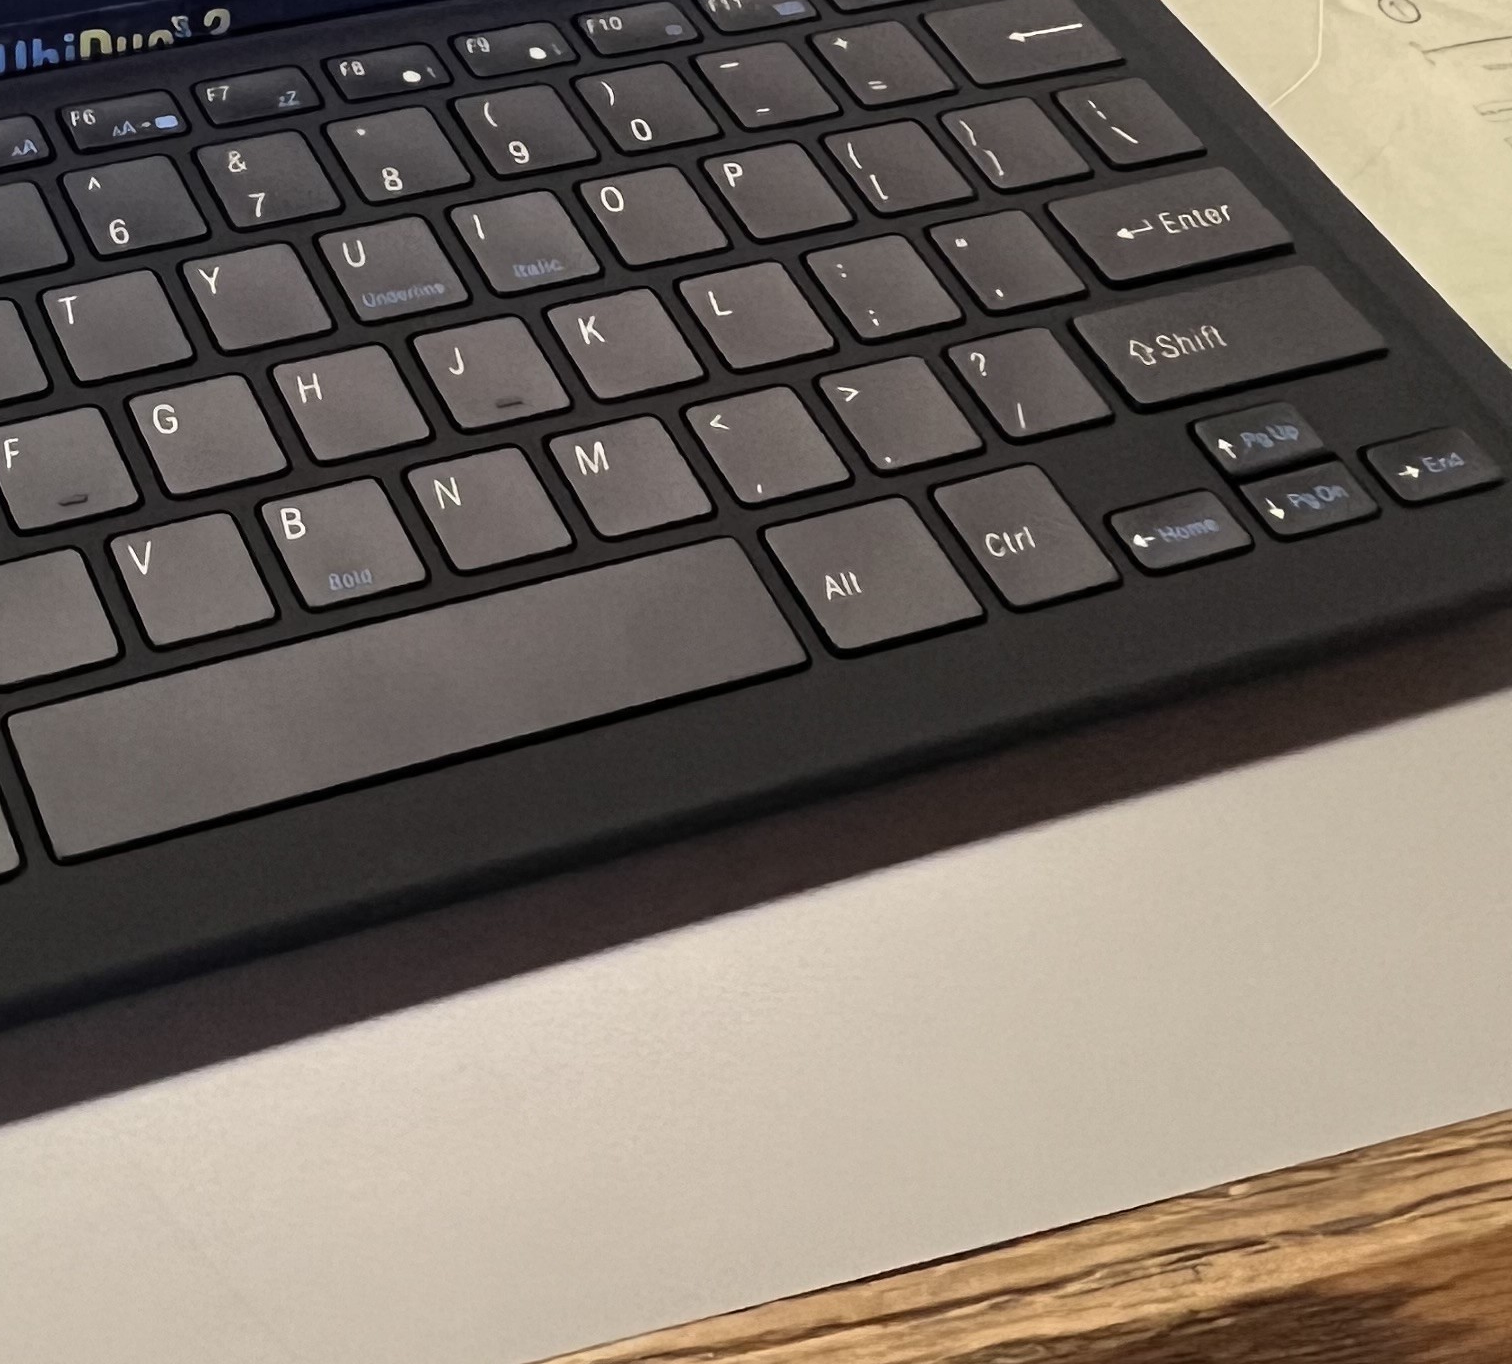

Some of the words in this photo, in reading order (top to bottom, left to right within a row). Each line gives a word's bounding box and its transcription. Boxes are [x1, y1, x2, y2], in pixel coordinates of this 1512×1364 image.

[586, 15, 623, 35] F10
[465, 36, 491, 55] F9
[206, 84, 230, 102] F7
[69, 108, 96, 128] F6
[630, 117, 653, 142] 0
[508, 139, 530, 165] 9
[381, 166, 403, 192] 8
[722, 161, 744, 188] P
[248, 192, 266, 218] 7
[1157, 202, 1233, 236] Enter
[108, 218, 130, 245] 6
[342, 239, 367, 268] U
[198, 265, 220, 295] Y
[57, 295, 78, 325] T
[707, 290, 734, 317] L
[577, 314, 606, 345] K
[1154, 323, 1229, 362] Shift
[448, 346, 465, 376] J
[296, 371, 323, 404] H
[152, 403, 179, 435] G
[2, 437, 20, 469] F
[573, 440, 609, 476] M
[432, 475, 463, 510] N
[279, 506, 307, 541] B
[984, 525, 1037, 559] Ctrl
[127, 540, 153, 576] V
[328, 567, 373, 592] Bold
